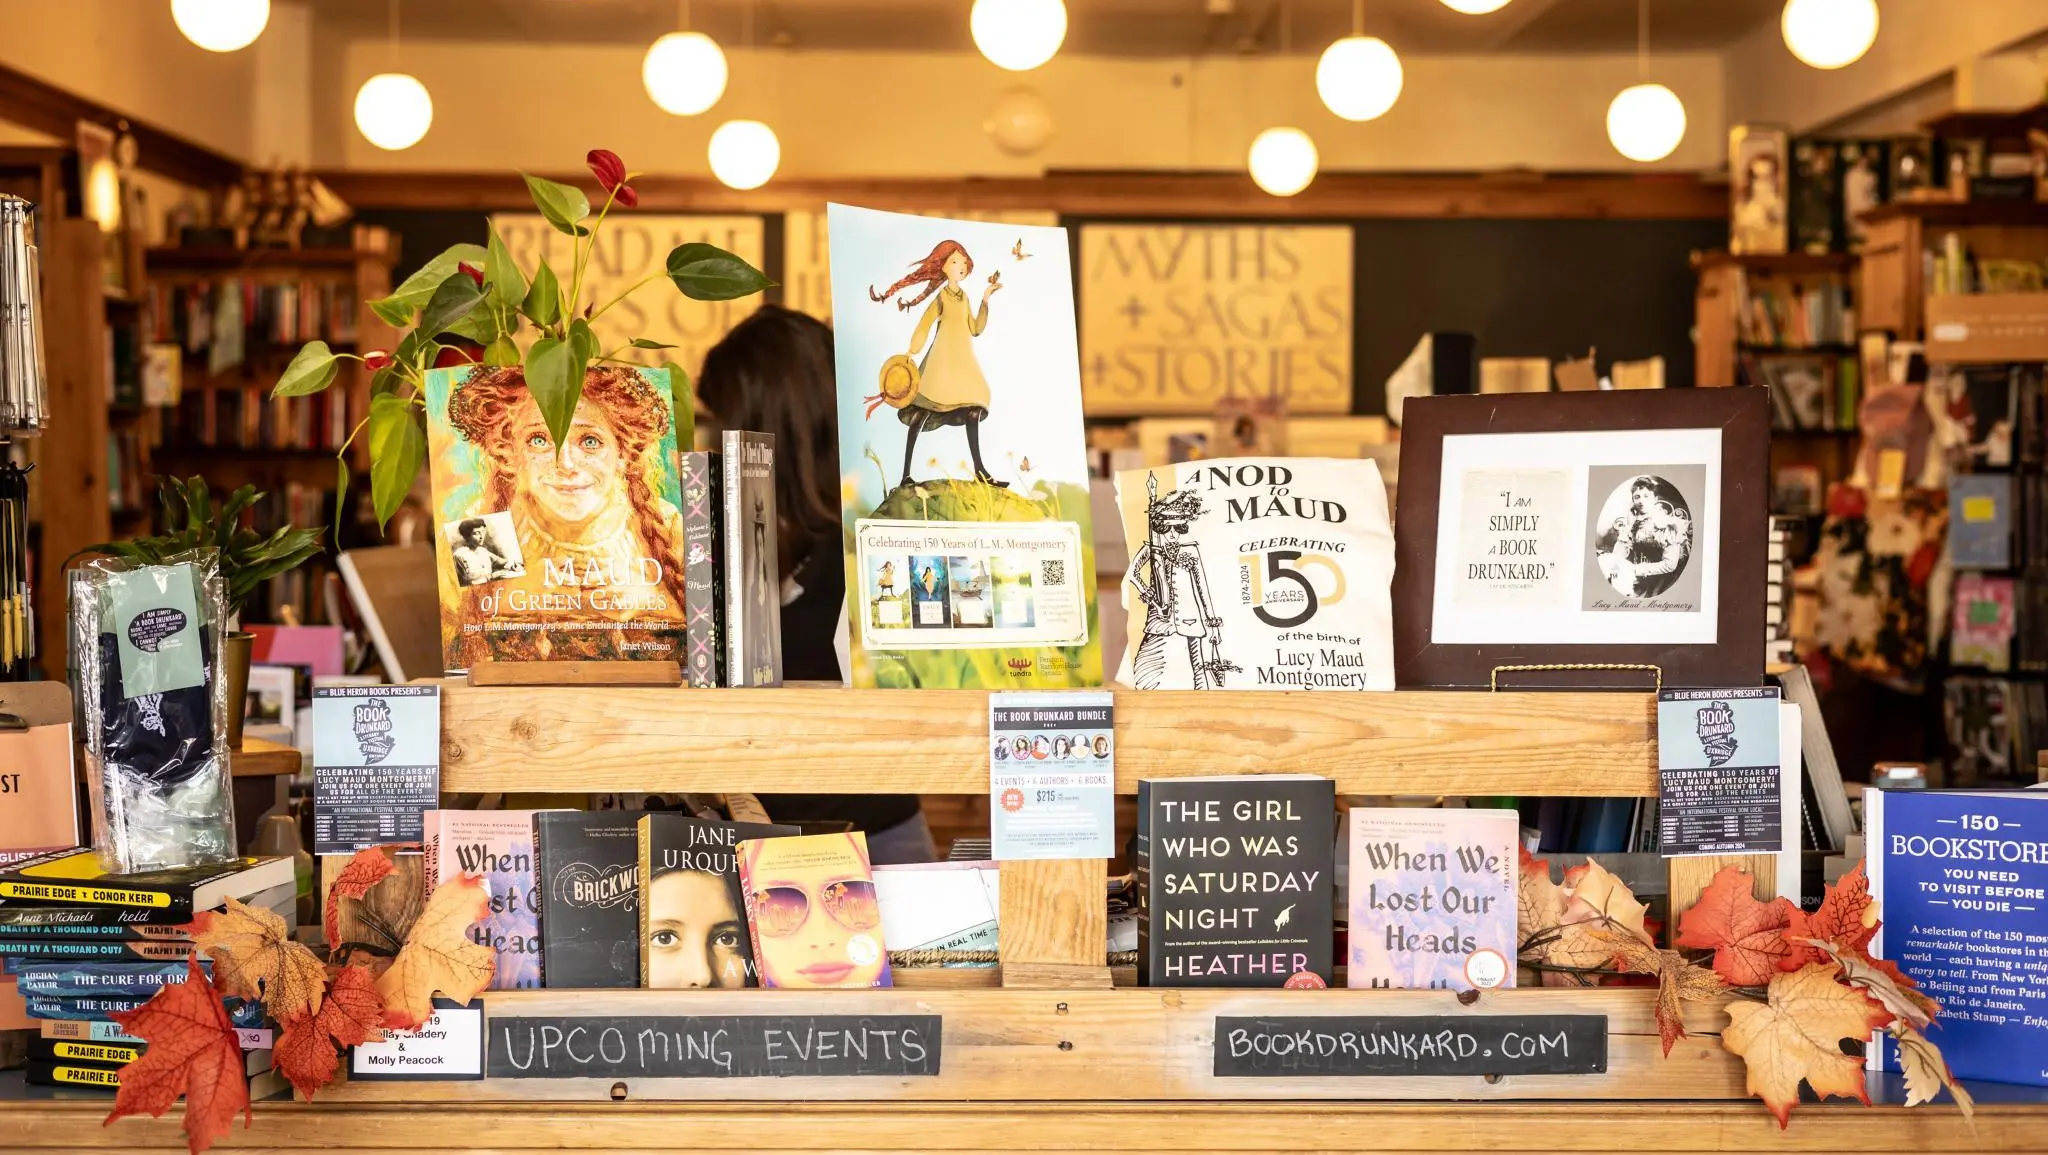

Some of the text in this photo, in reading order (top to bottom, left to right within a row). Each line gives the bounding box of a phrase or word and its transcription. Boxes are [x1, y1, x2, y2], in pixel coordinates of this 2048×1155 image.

[1091, 228, 1301, 281] MYTHS
[1161, 287, 1344, 340] SAGAS
[1185, 465, 1293, 491] A NOD
[1270, 486, 1290, 497] to
[1225, 496, 1347, 524] MAUD
[1514, 497, 1532, 508] AM
[1489, 515, 1540, 531] SIMPLY
[868, 537, 1067, 552] Celebrating 150 Years of Montgomery
[1239, 536, 1346, 553] CELEBRATING
[1488, 539, 1537, 556] A BOOK
[543, 557, 663, 587] MAUD
[1239, 551, 1346, 628] 150
[1242, 565, 1251, 605] 1874-2024
[481, 587, 667, 617] of GREEN GABLES
[1264, 590, 1304, 599] YEARS
[1592, 599, 1612, 609] Lucy
[1643, 599, 1694, 611] Montgomery
[464, 623, 482, 632] How
[587, 621, 629, 631] Enchanted
[630, 621, 643, 630] the
[644, 621, 669, 630] World
[620, 641, 671, 651] Janet Wilson
[1277, 632, 1361, 646] of the birth of
[1276, 649, 1364, 668] Lucy Maud
[1257, 667, 1367, 691] Montgomery
[330, 687, 421, 696] BLUE HERON BOOKS PRESENTS
[1674, 689, 1763, 700] BLUE HERON BOOKS PRESENTS
[356, 708, 389, 722] BOOK
[994, 710, 1106, 722] THE BOOK DRUNKARD BUNDLE
[1700, 710, 1732, 724] BOOK
[356, 721, 391, 734] DRUNKARD
[1700, 723, 1733, 737] DRUNKARD
[1001, 776, 1107, 786] EVENTS AUTHORS BOOKS
[1662, 770, 1718, 779] CELEBRATING
[1663, 778, 1684, 787] LUCY
[1714, 775, 1775, 784] MONTGOMERY!
[1036, 790, 1056, 802] $215
[1160, 800, 1301, 822] THE GIRL
[1960, 815, 1999, 831] 150
[688, 825, 737, 848] JANE
[1162, 835, 1299, 858] WHO WAS
[456, 844, 530, 873] When
[1365, 842, 1501, 874] When We
[1163, 871, 1320, 895] SATURDAY
[1943, 869, 2019, 882] YOU NEED
[12, 885, 154, 904] PRAIRIE EDGE CONOR KERR
[1369, 883, 1495, 914] Lost Our
[1919, 882, 2045, 899] TO VISIT BEFORE
[742, 877, 754, 922] LUCKY
[1952, 899, 2010, 912] YOU DIE
[14, 910, 151, 924] Anne Michaels held
[1164, 907, 1259, 931] NIGHT
[947, 928, 988, 949] REAL TIME
[1385, 924, 1477, 955] Heads
[1911, 925, 2023, 941] A selection of the 150
[0, 944, 123, 954] DEATH BY A THOUSAND CUTS
[1906, 937, 2035, 956] remarkable bookstores in
[1165, 953, 1308, 977] HEATHER
[1903, 951, 2013, 971] world each having
[74, 974, 163, 986] THE CURE FOR
[1909, 967, 2025, 984] story to tell. From New
[27, 980, 58, 989] PAYLOR
[1929, 980, 2046, 999] Beijing and from Paris
[1949, 995, 2026, 1012] Rio de Janeiro.
[67, 1046, 131, 1060] PRAIRIE EDGE
[398, 1043, 406, 1051] &
[504, 1026, 929, 1070] UPCOMING EVENTS
[368, 1055, 444, 1066] Molly Peacock
